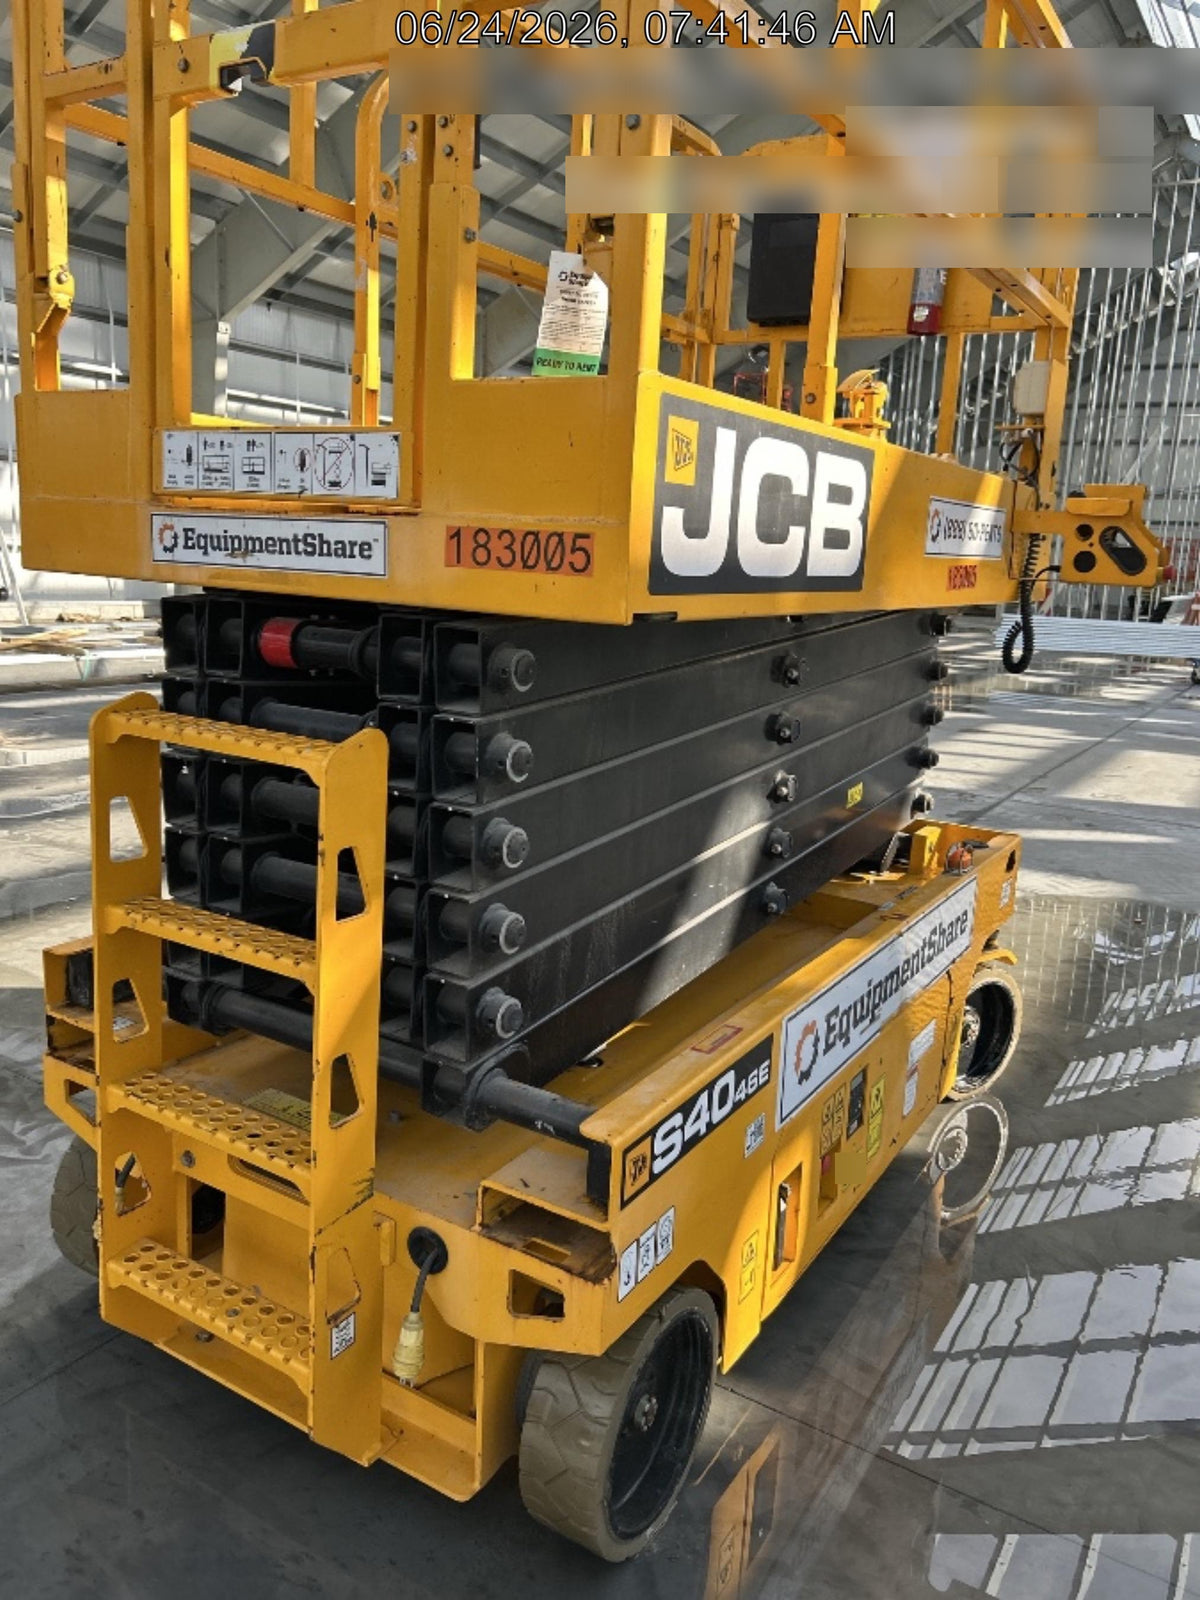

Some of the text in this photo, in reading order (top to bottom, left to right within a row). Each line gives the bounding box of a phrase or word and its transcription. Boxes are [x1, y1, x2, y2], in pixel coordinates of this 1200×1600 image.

[182, 527, 373, 560] EquipmentShare
[449, 526, 592, 573] 183005
[661, 426, 867, 577] JCB
[823, 908, 969, 1056] EquipmentShare
